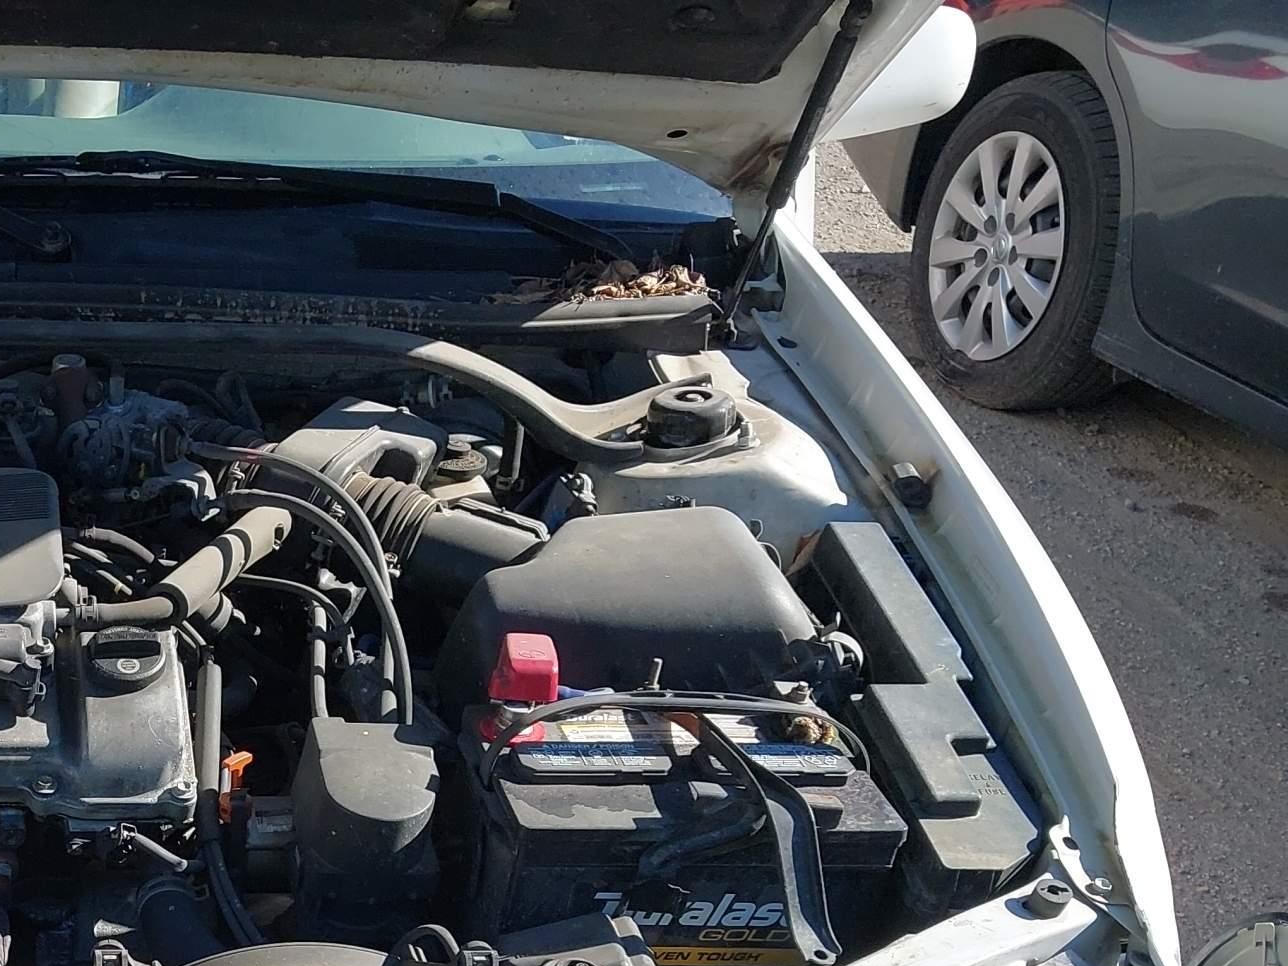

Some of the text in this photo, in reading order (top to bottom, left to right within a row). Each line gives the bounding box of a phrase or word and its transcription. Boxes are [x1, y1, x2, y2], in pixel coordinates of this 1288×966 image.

[594, 892, 788, 927] ualas
[698, 929, 791, 942] GOLD
[697, 952, 764, 962] TOUGH
